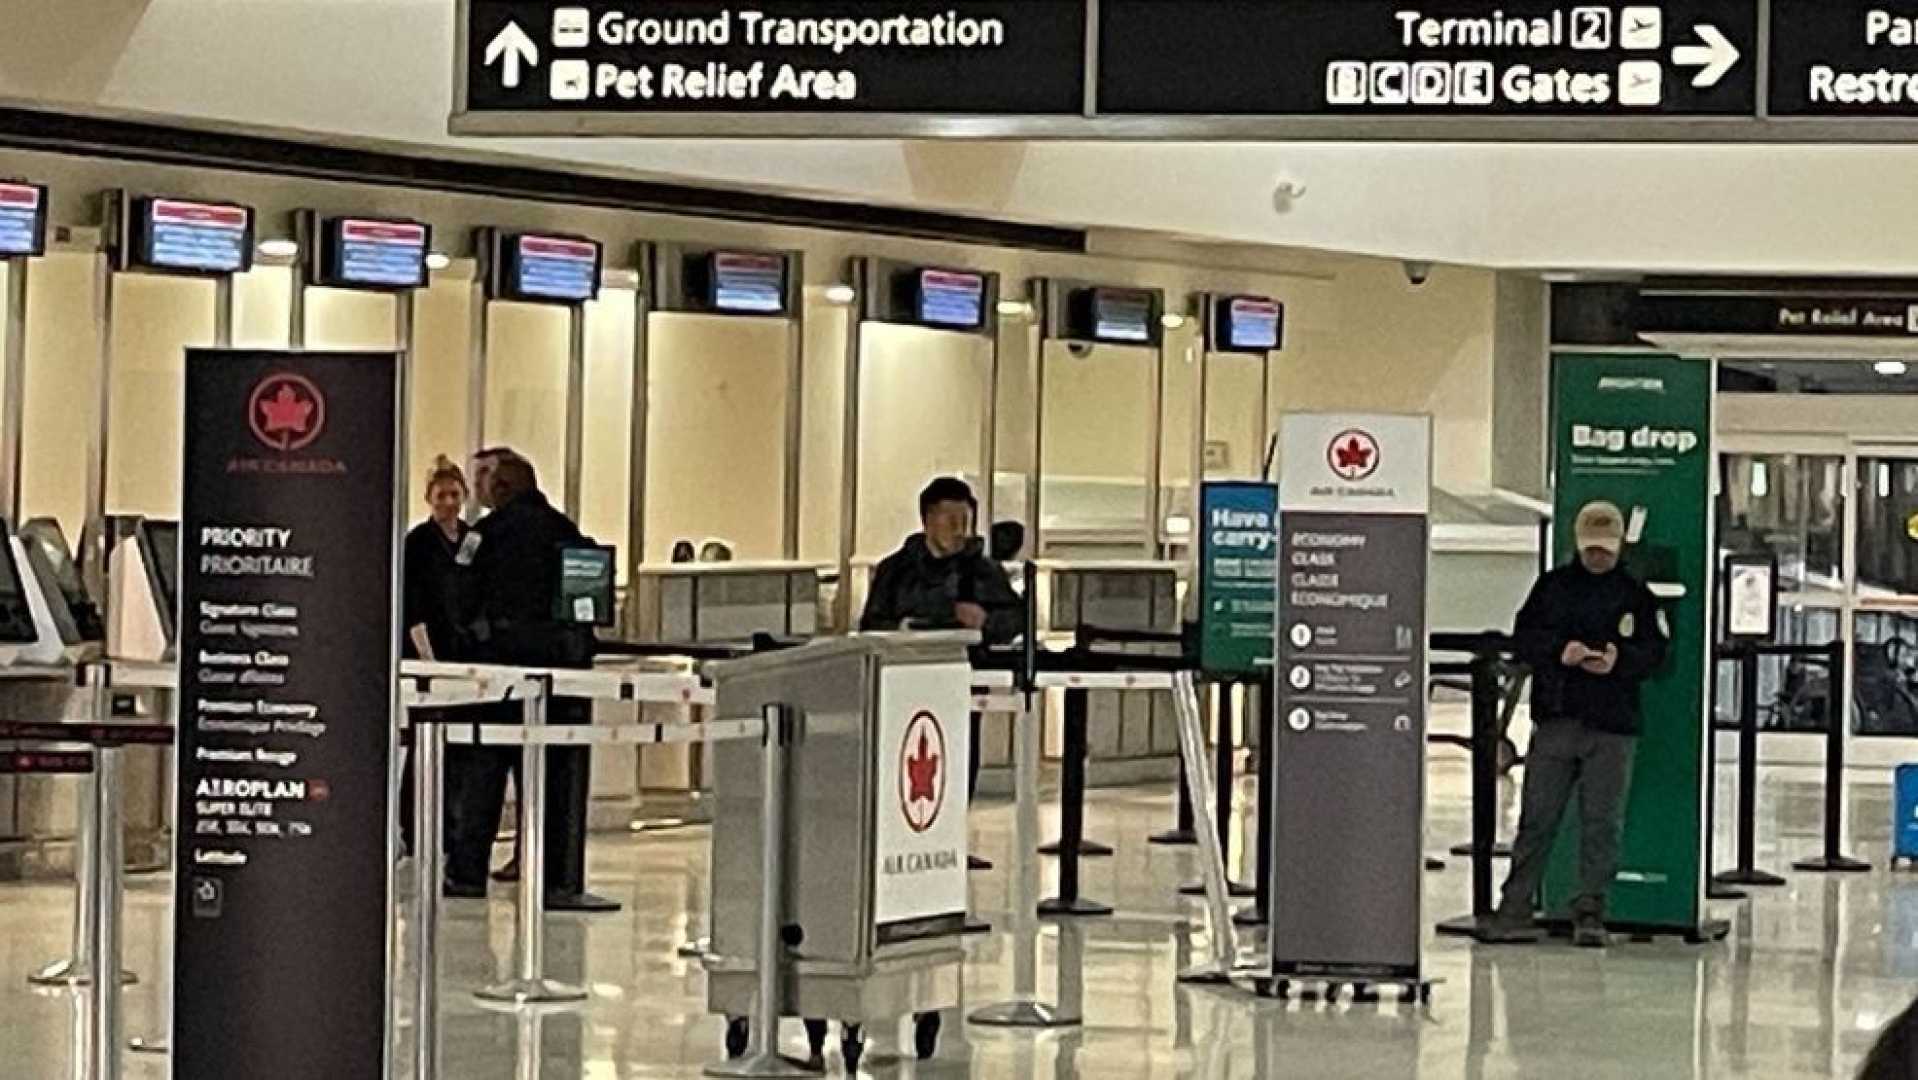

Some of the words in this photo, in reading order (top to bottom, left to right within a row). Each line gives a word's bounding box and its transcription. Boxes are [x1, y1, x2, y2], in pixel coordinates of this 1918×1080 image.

[598, 11, 730, 45] Ground
[739, 11, 1004, 53] Transportation
[1395, 10, 1561, 46] Terminal
[596, 63, 654, 99] Pet
[662, 61, 765, 99] Relief
[769, 64, 857, 99] Area
[1501, 67, 1611, 103] Gates
[1573, 425, 1625, 452] Bag
[1631, 426, 1697, 454] drop
[1212, 508, 1269, 528] Have
[202, 526, 292, 548] PRIORITY
[201, 554, 315, 577] PRIORITAIRE
